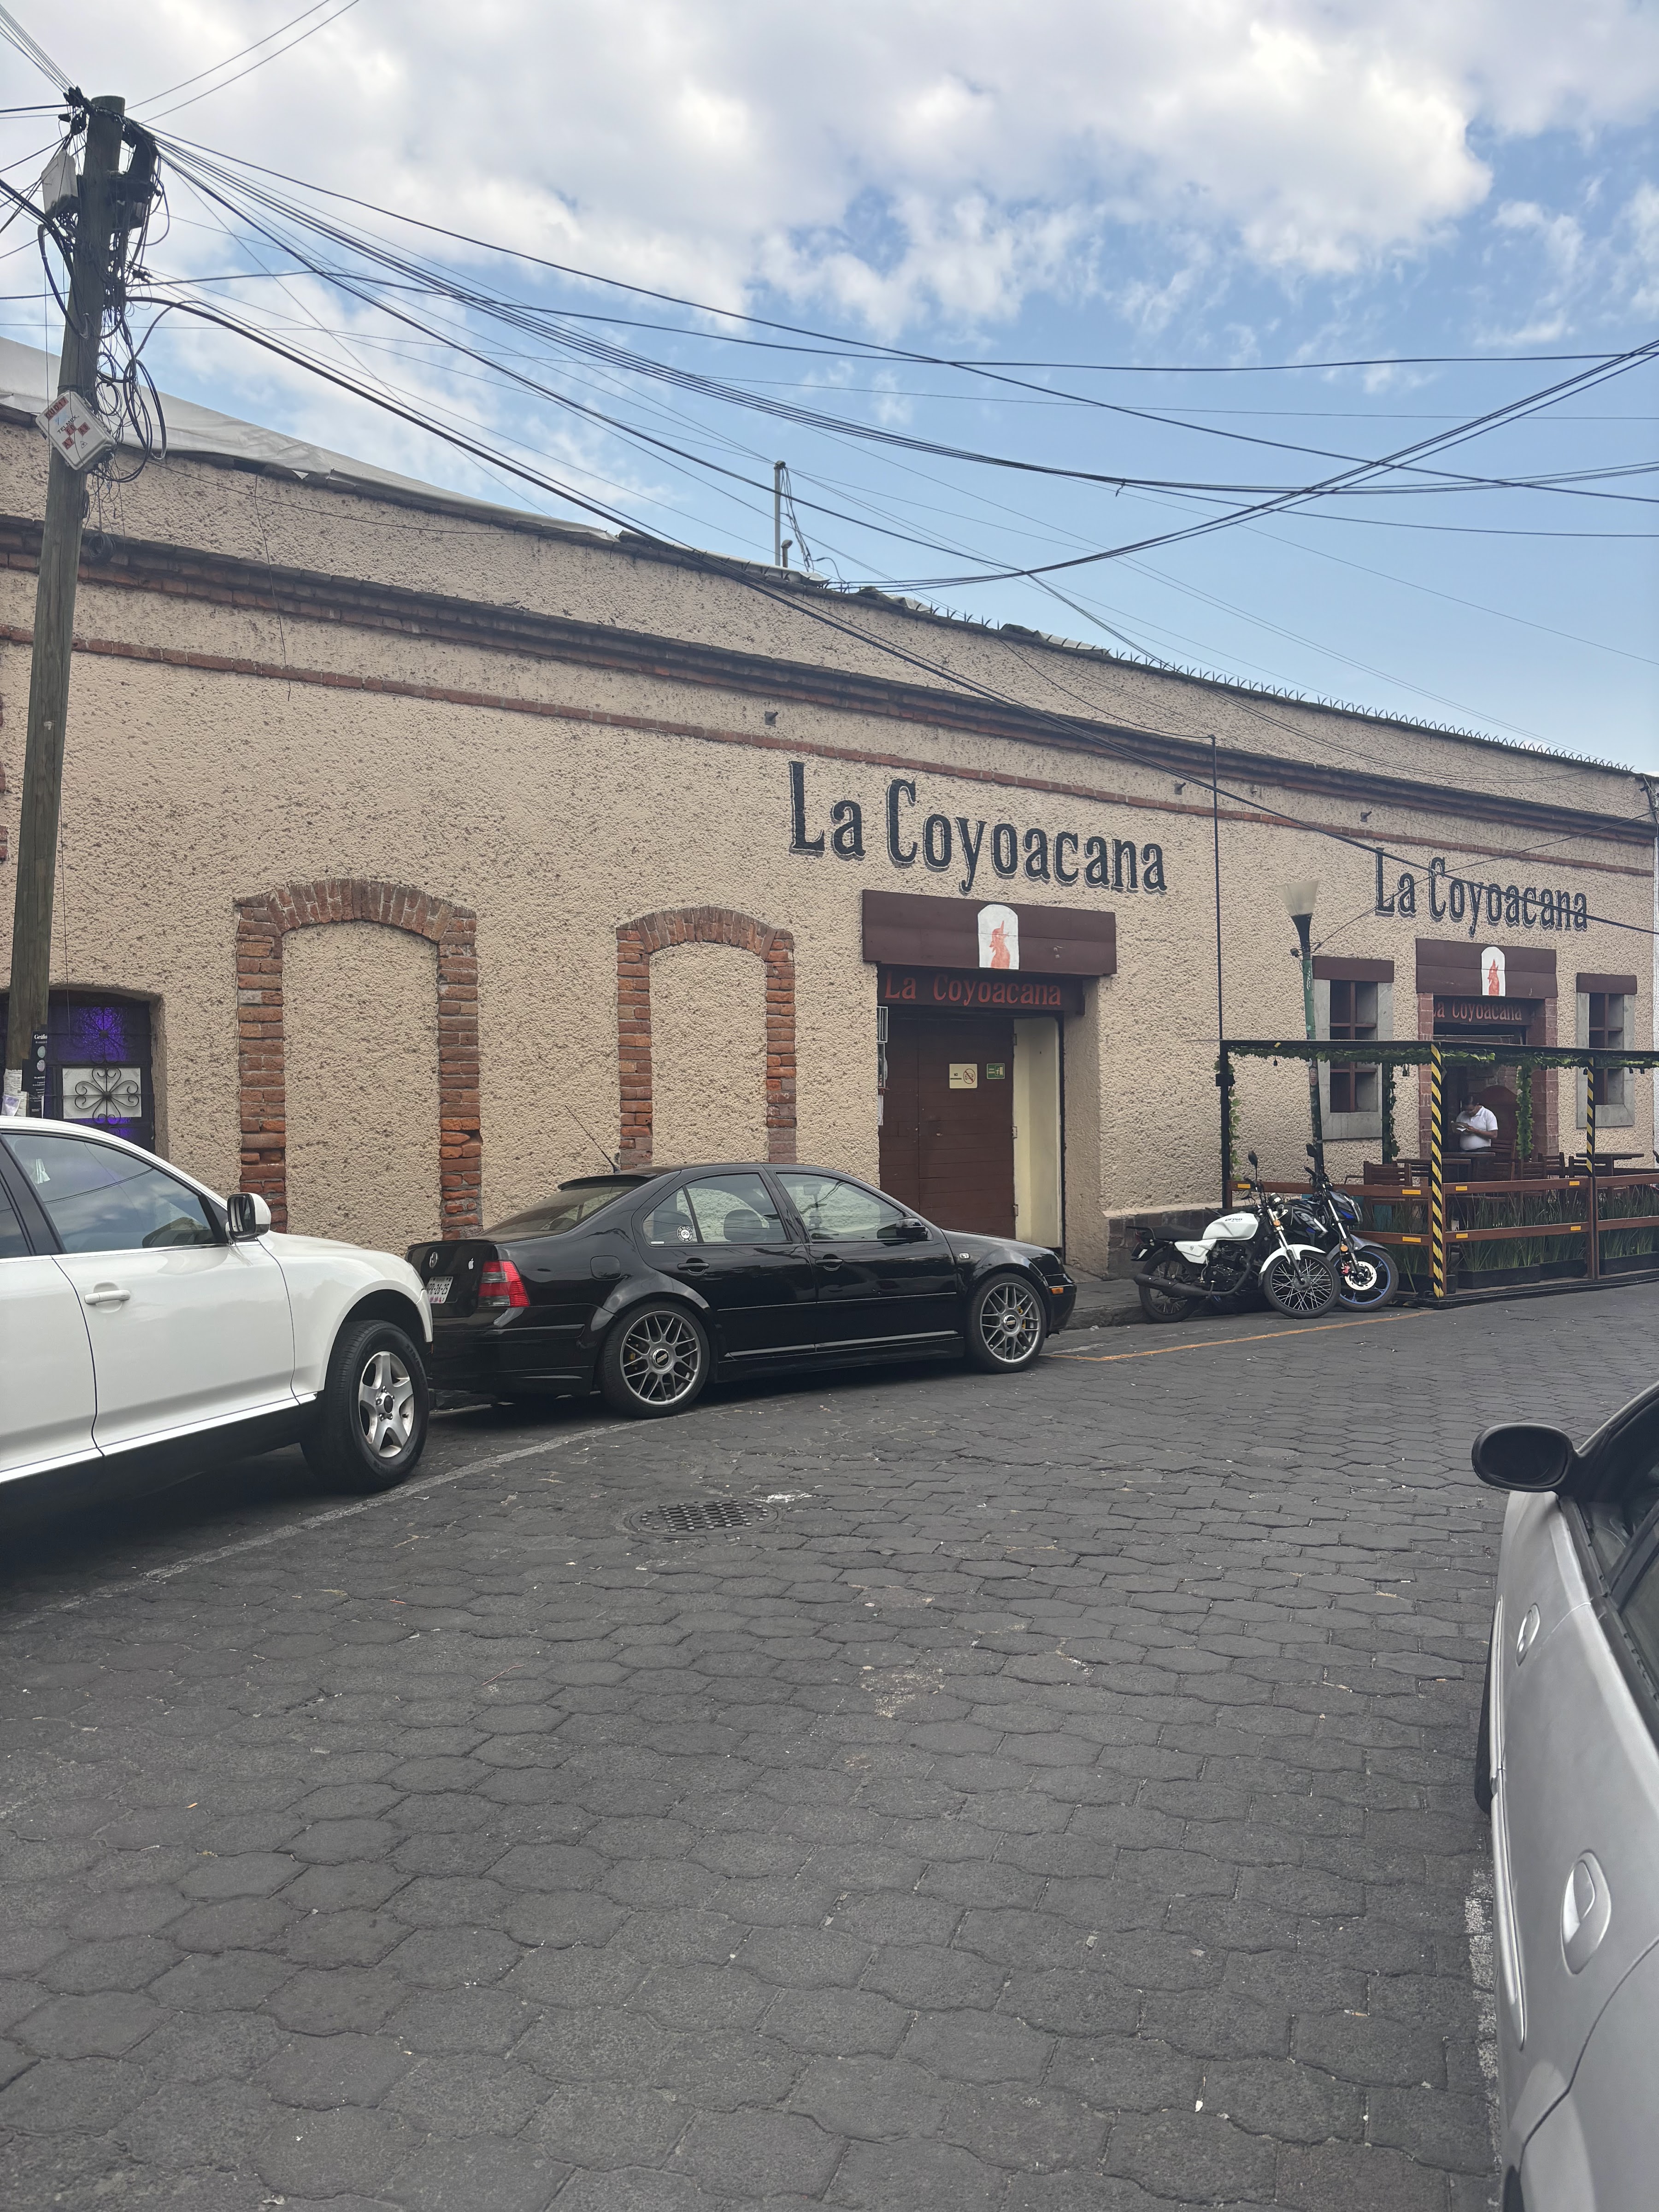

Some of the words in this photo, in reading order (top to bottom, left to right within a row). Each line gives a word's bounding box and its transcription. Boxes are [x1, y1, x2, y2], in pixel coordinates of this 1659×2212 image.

[57, 415, 78, 434] TELMEX
[789, 760, 865, 859] La
[887, 778, 1167, 894] Coyoacana
[1375, 847, 1417, 917] La
[1429, 856, 1588, 937] Coyoacana
[885, 971, 916, 1000] La
[933, 973, 1061, 1006] Coyoacana
[1453, 999, 1522, 1022] Coyoacana
